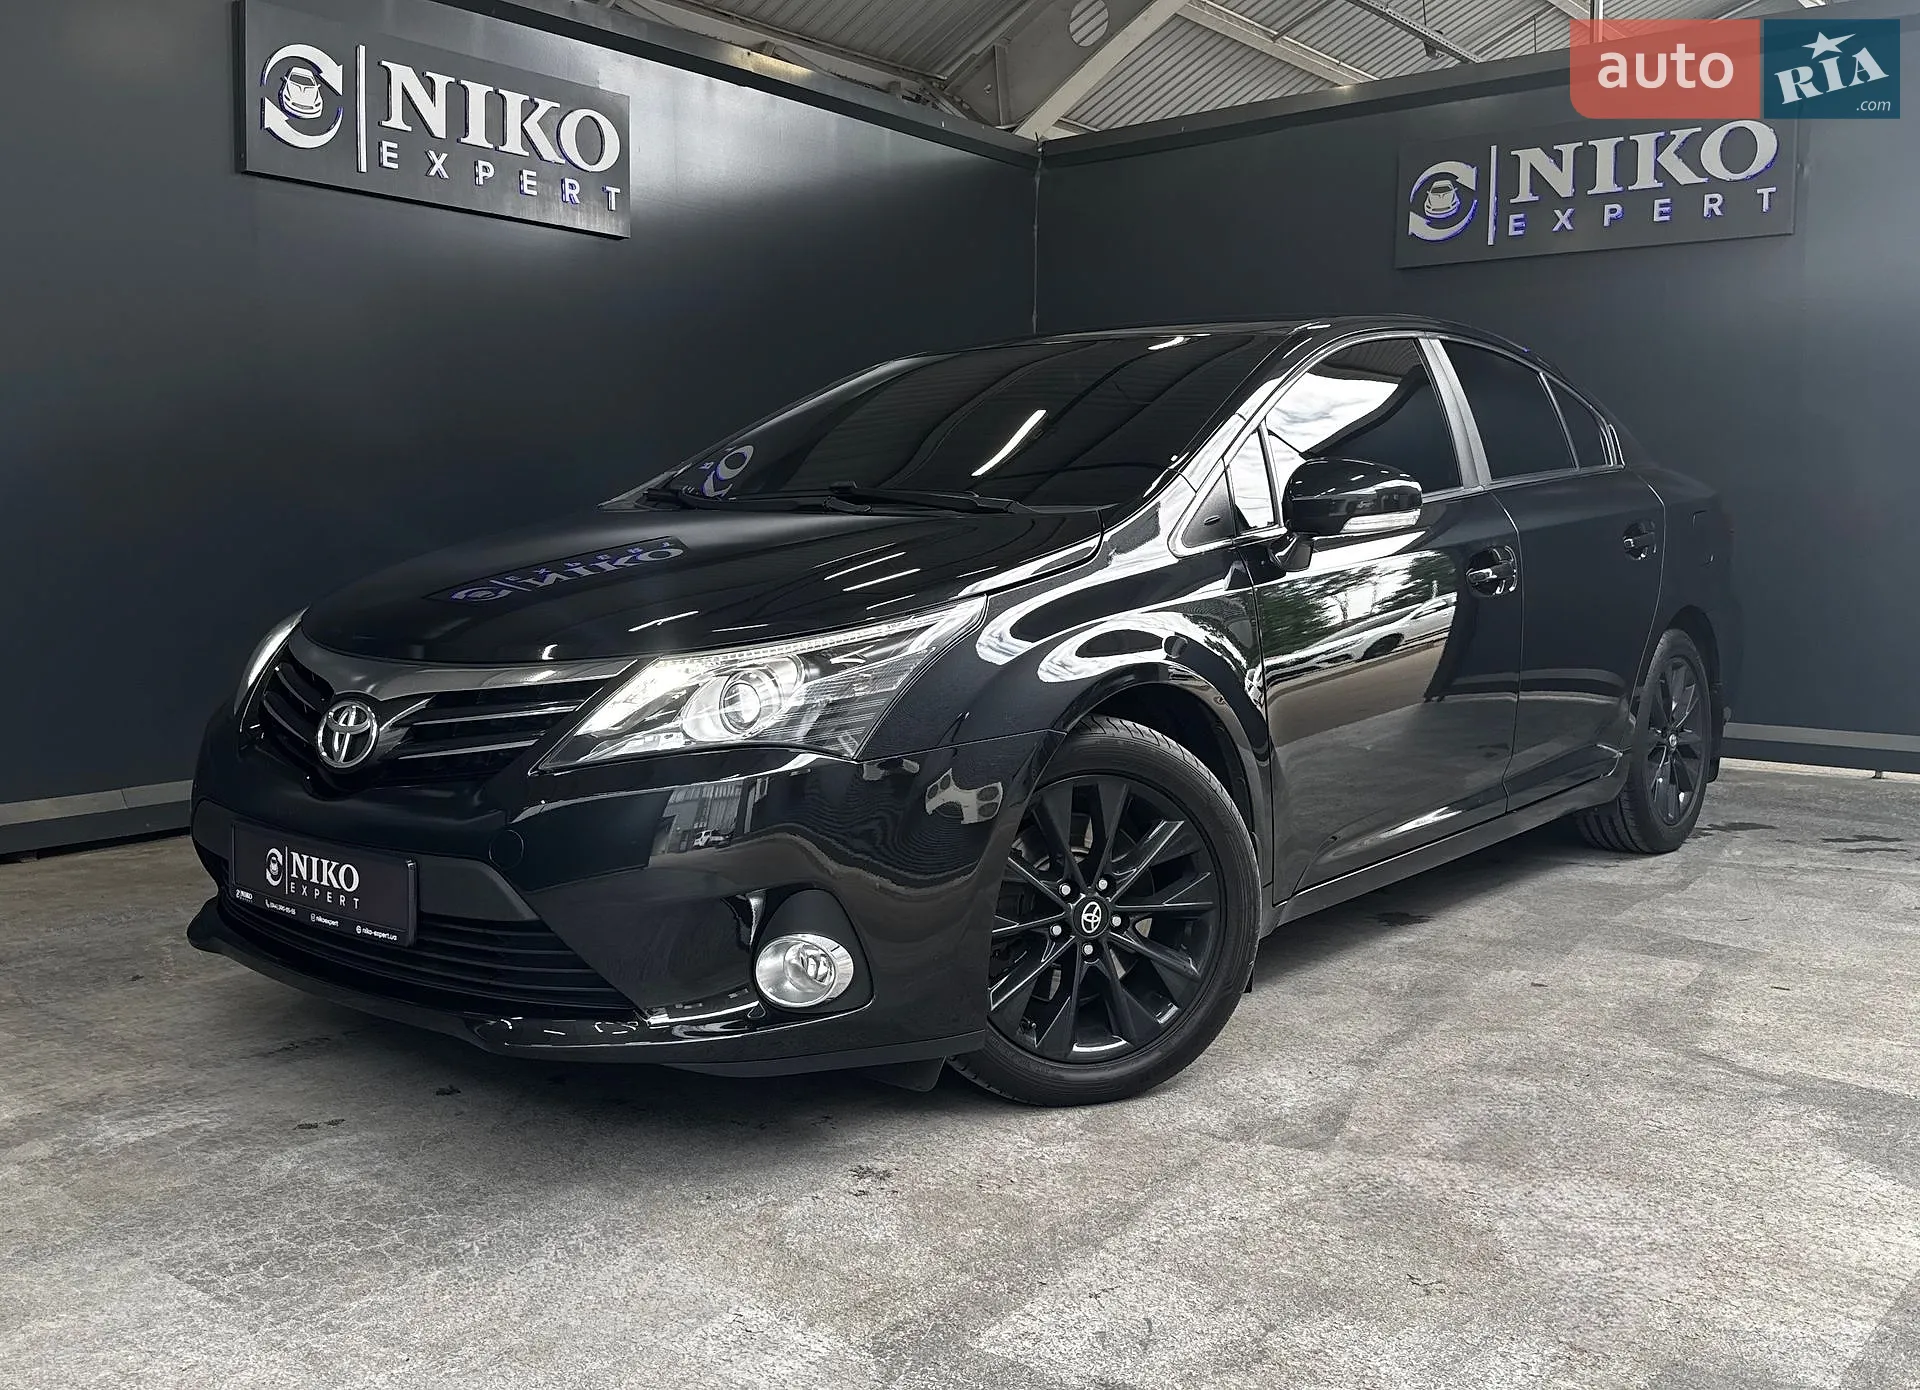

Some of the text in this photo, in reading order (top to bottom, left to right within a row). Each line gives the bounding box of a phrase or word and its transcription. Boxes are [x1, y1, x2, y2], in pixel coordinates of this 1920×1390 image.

[378, 60, 622, 173] NIKO
[378, 140, 622, 212] EXPERT
[1509, 120, 1780, 205] NIKO
[1507, 187, 1778, 237] EXPERT
[289, 881, 361, 910] EXPERT
[290, 851, 360, 892] NIKO
